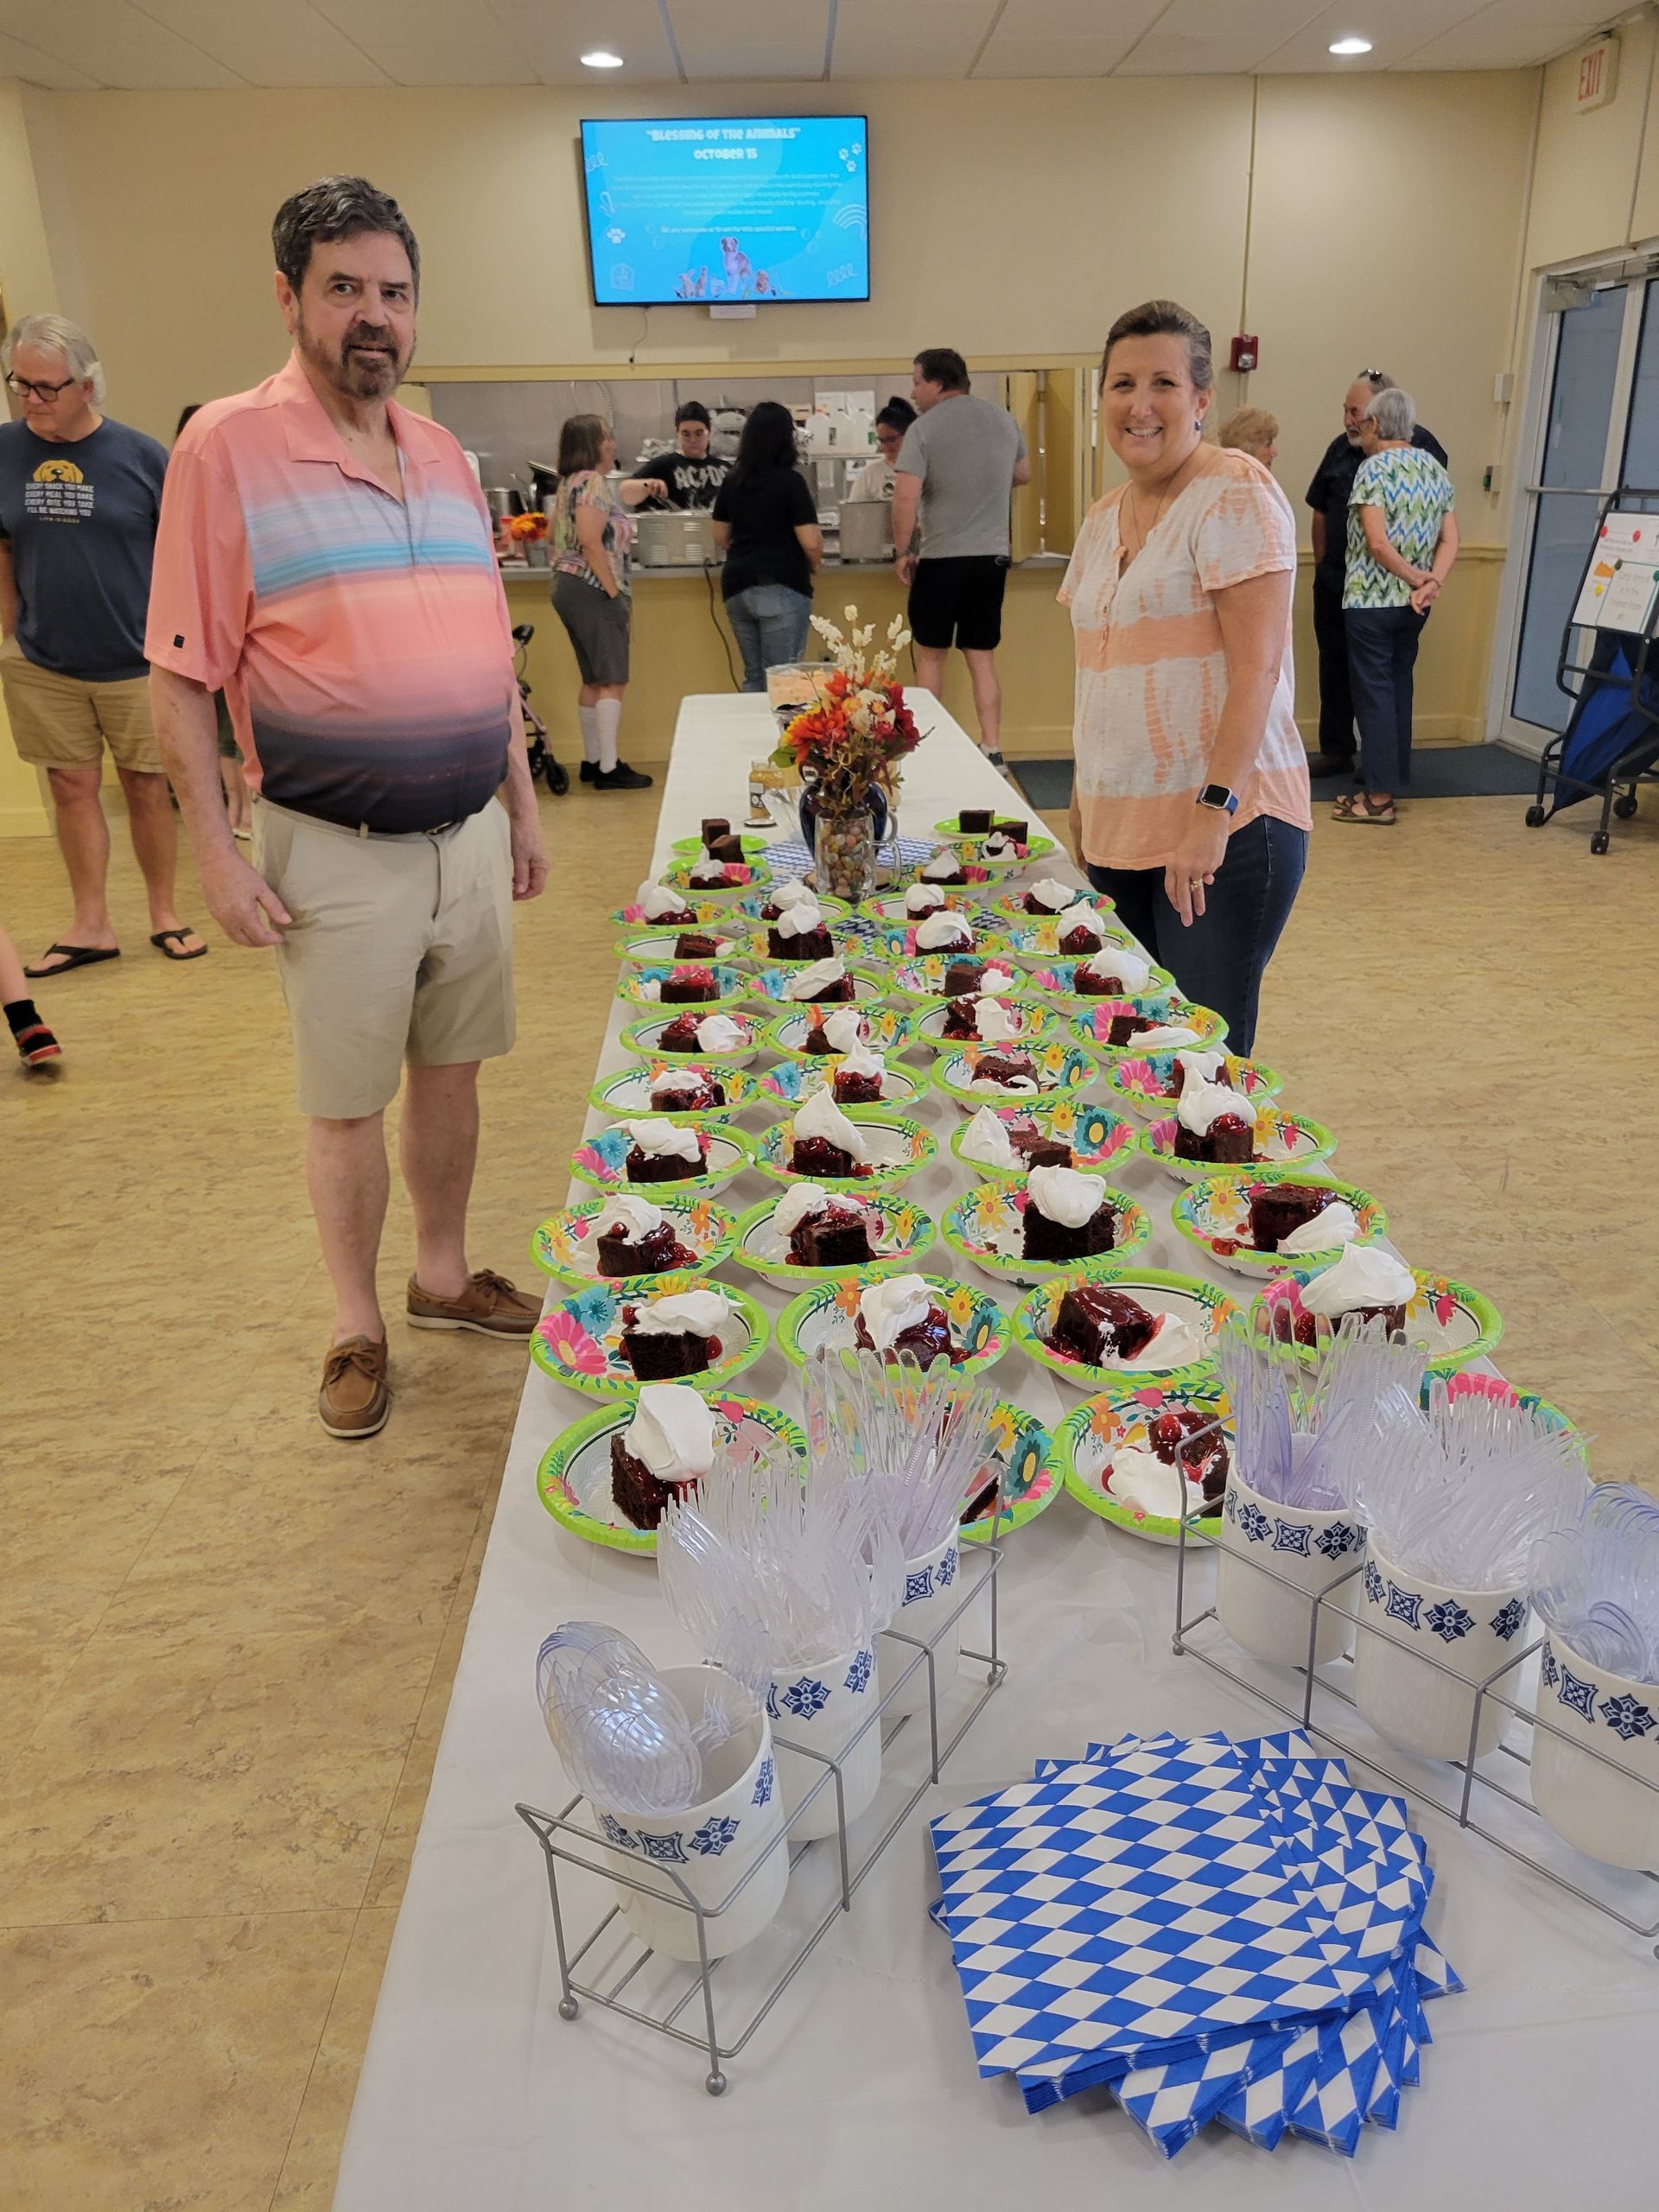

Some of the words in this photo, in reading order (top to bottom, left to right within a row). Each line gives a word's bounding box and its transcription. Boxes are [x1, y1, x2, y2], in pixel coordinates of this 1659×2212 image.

[1578, 48, 1605, 102] EXIT
[706, 129, 721, 140] OF
[693, 148, 744, 160] OCTOBER
[746, 148, 759, 160] 15
